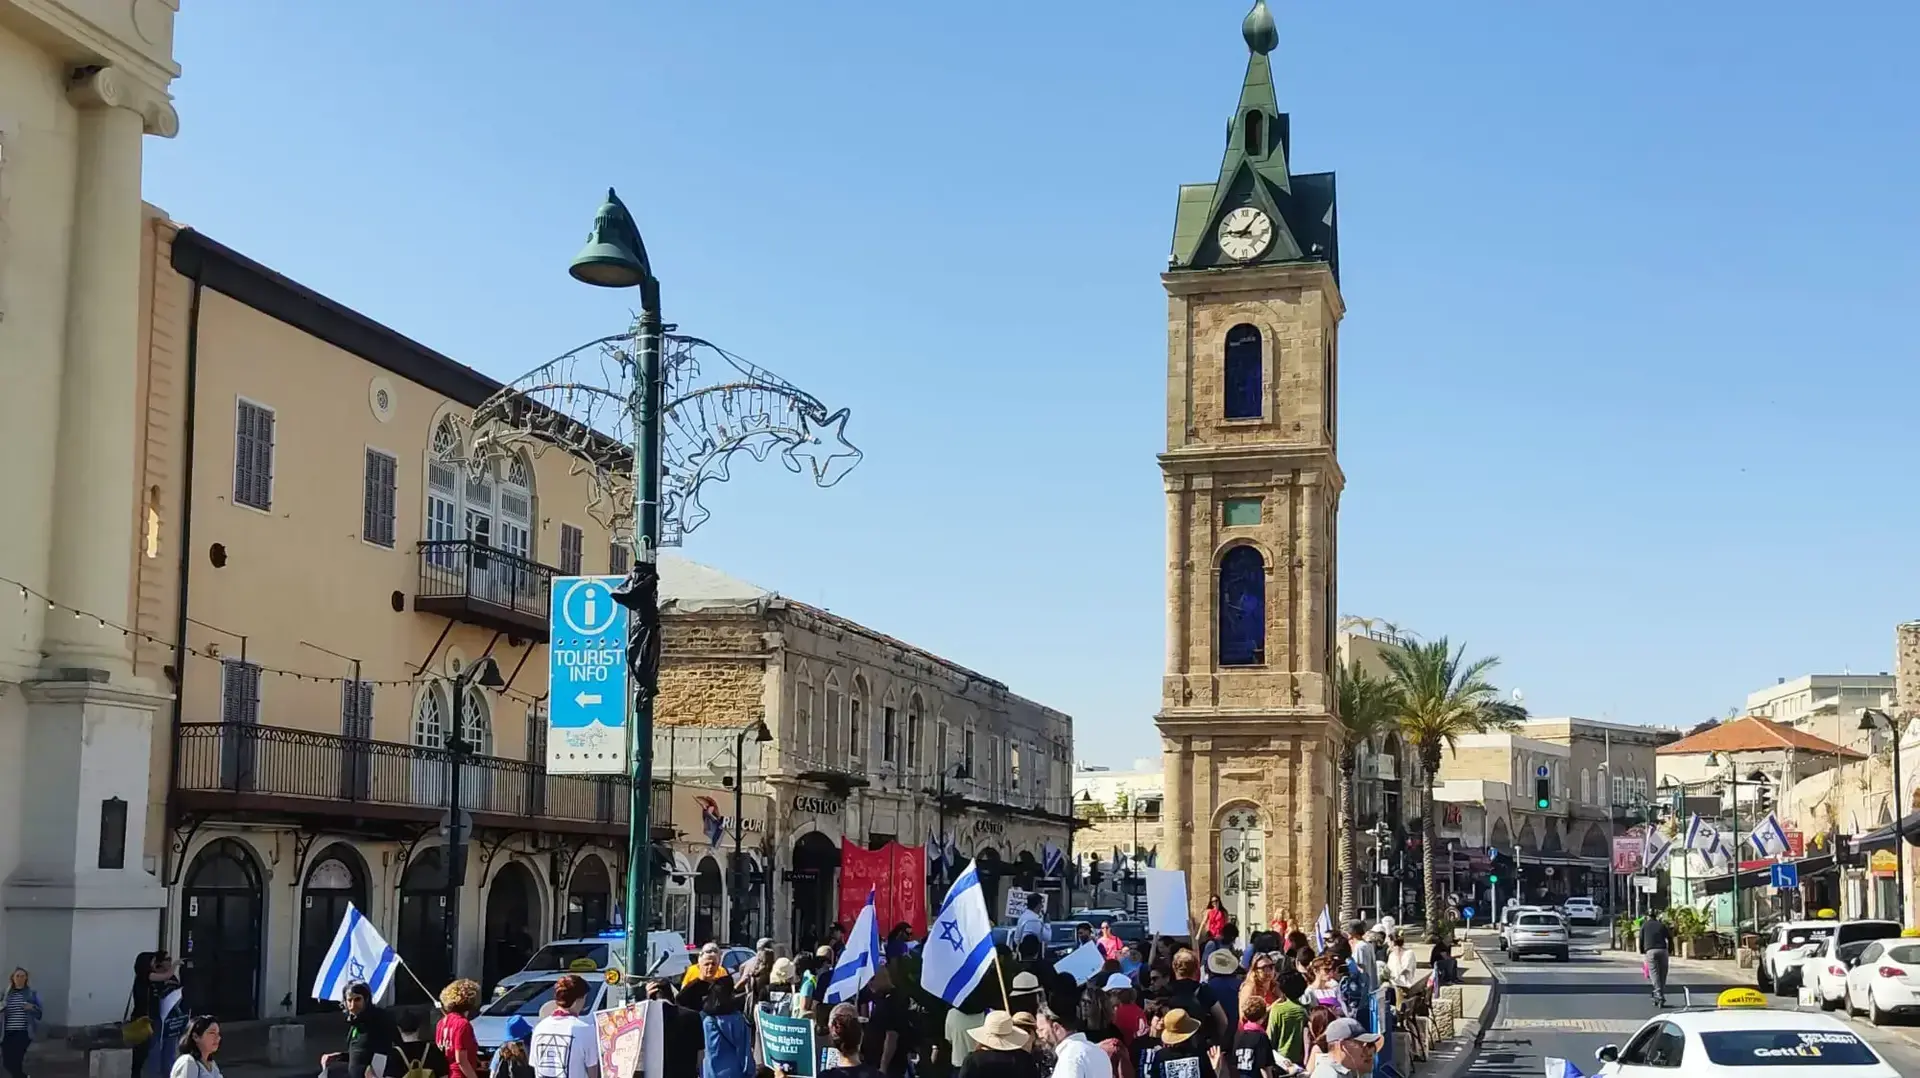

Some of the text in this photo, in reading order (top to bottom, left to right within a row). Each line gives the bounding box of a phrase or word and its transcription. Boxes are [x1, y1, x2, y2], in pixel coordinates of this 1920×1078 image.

[554, 649, 624, 666] TOURIST
[569, 666, 608, 682] INFO
[796, 796, 839, 814] CASTRO
[741, 817, 766, 832] CURL
[778, 1036, 804, 1046] Rights
[780, 1045, 798, 1054] ALL!
[1753, 1047, 1798, 1057] Gett
